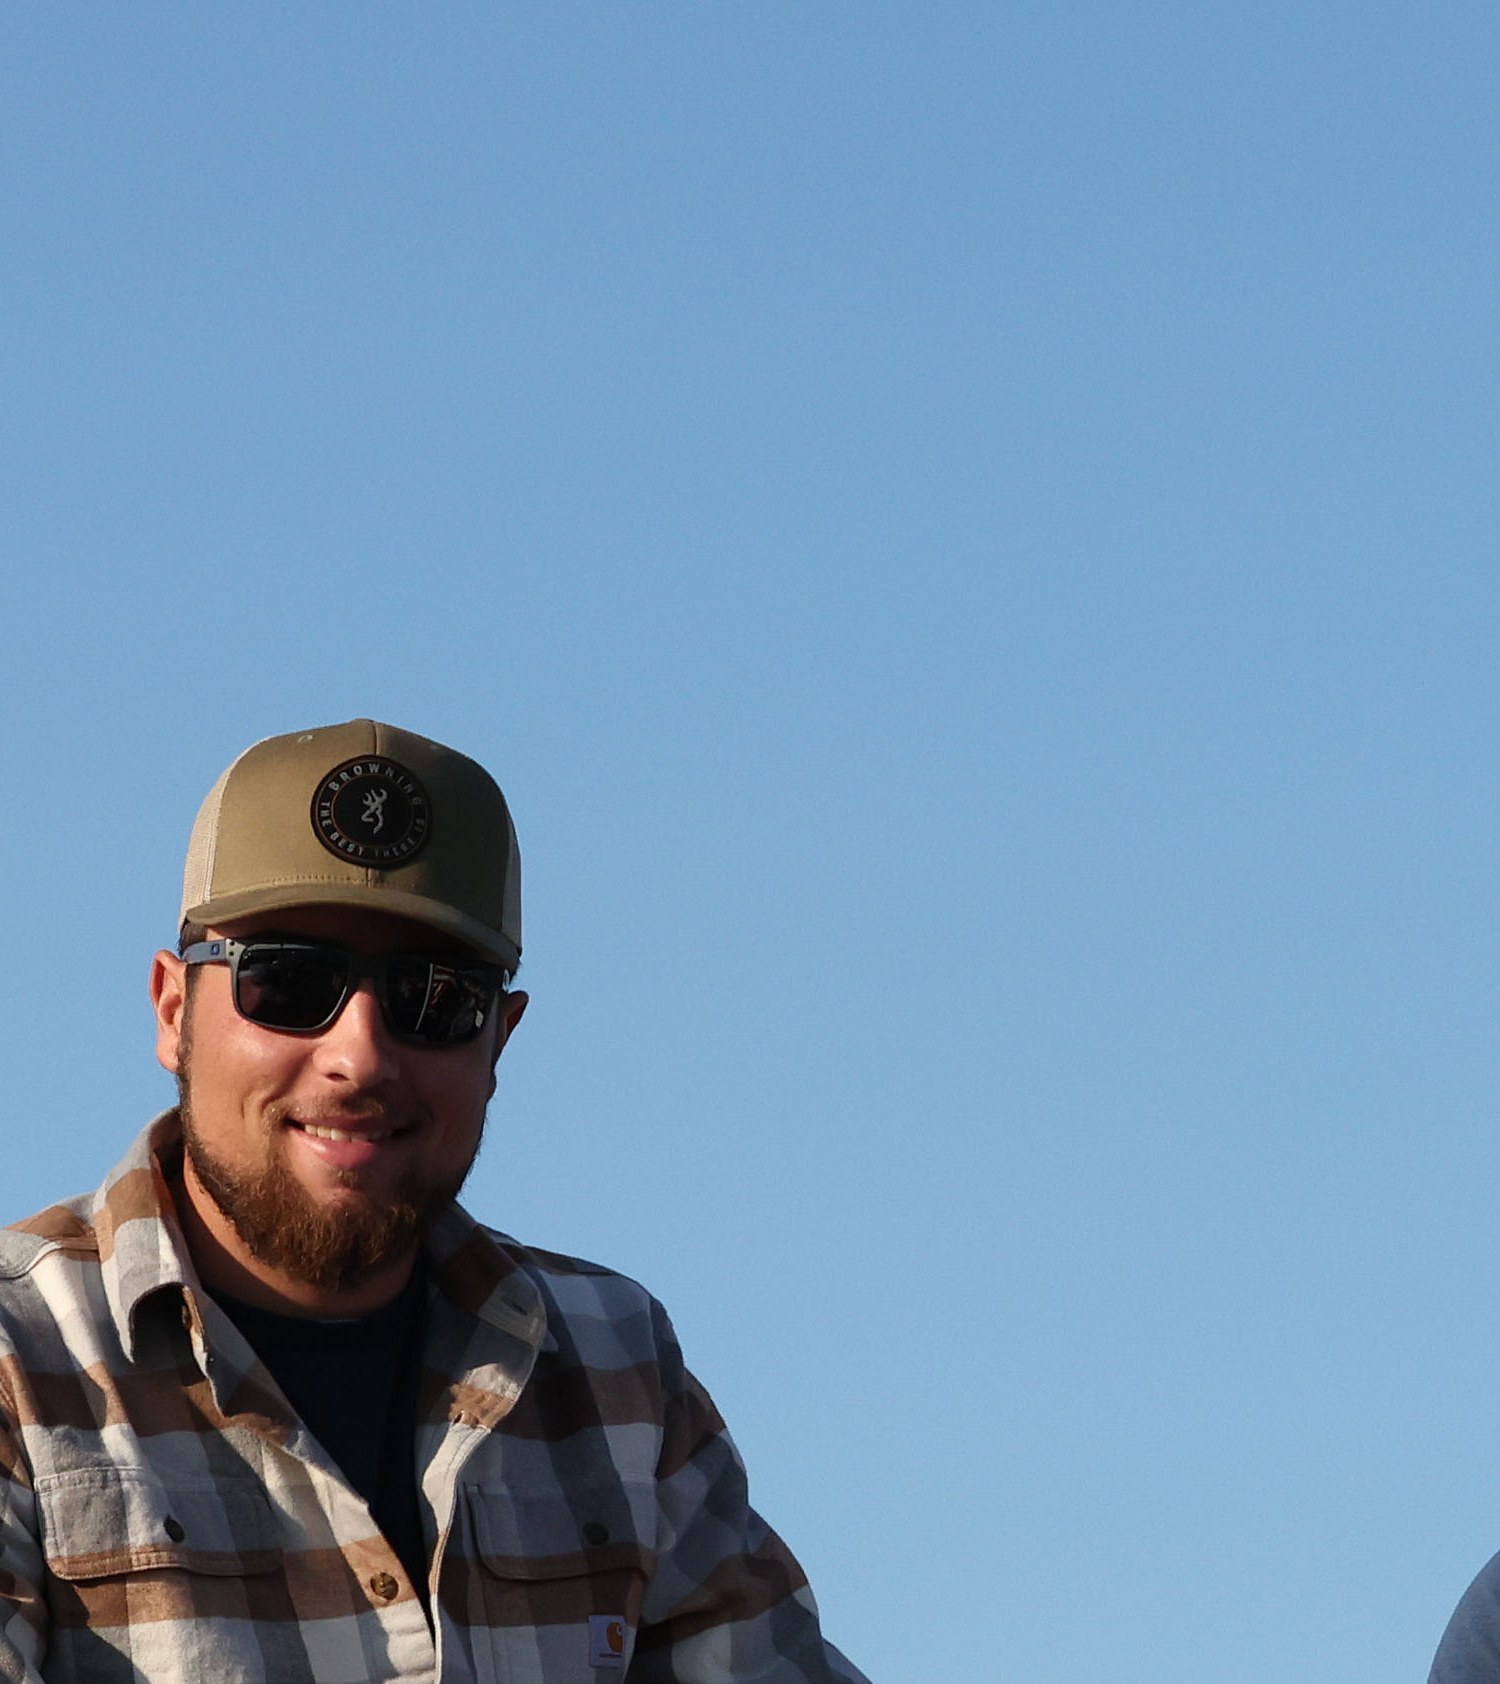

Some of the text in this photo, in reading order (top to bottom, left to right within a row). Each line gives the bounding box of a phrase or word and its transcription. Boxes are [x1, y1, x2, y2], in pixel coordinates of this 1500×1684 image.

[328, 763, 422, 805] BROWNING
[320, 801, 333, 828] THE
[329, 832, 364, 857] BEST
